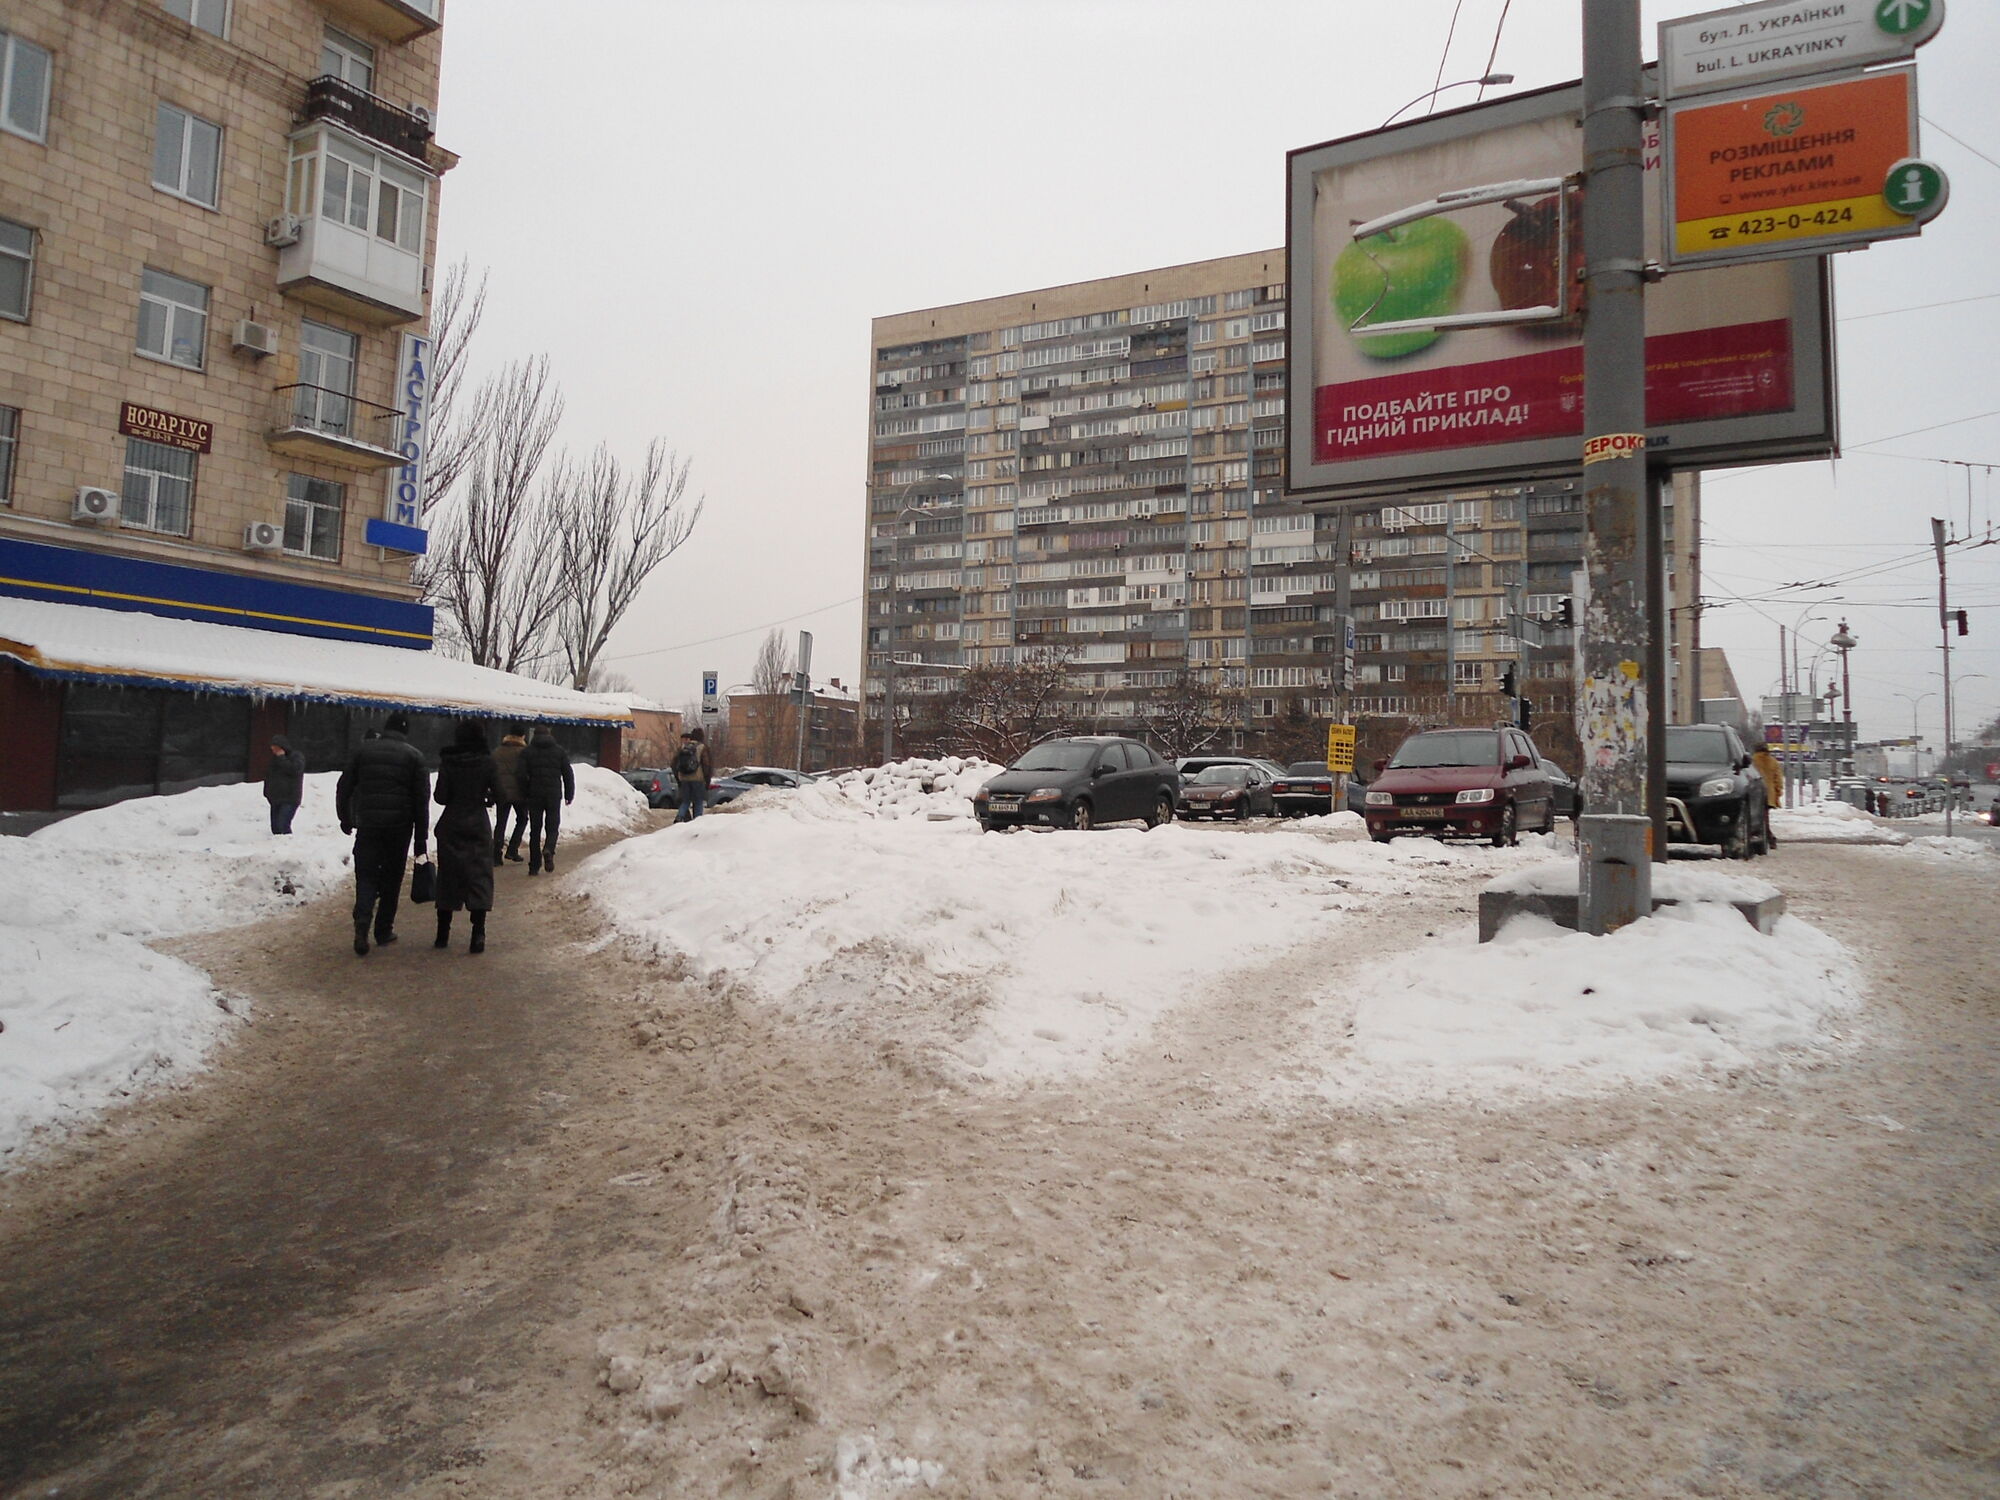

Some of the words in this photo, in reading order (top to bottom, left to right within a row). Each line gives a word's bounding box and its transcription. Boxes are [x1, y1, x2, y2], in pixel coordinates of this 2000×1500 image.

[1700, 28, 1733, 43] бул.
[1737, 24, 1754, 36] Л.
[1758, 4, 1846, 32] УКРАЇНКИ
[1696, 58, 1726, 74] bul.
[1730, 55, 1743, 67] L.
[1748, 35, 1847, 64] UKRAYINKY
[1709, 128, 1856, 164] РОЗМІЩЕННЯ
[1730, 154, 1835, 183] РЕКЛАМИ
[1738, 207, 1854, 236] 423-0-424
[126, 405, 208, 441] НОТАРІУС
[1343, 390, 1457, 423] ПОДБАЙТЕ
[1464, 385, 1511, 406] ПРО
[397, 338, 427, 525] ГАСТРОНОМ
[1327, 417, 1407, 447] ГІДНИЙ
[1412, 403, 1529, 434] ПРИКЛАД!
